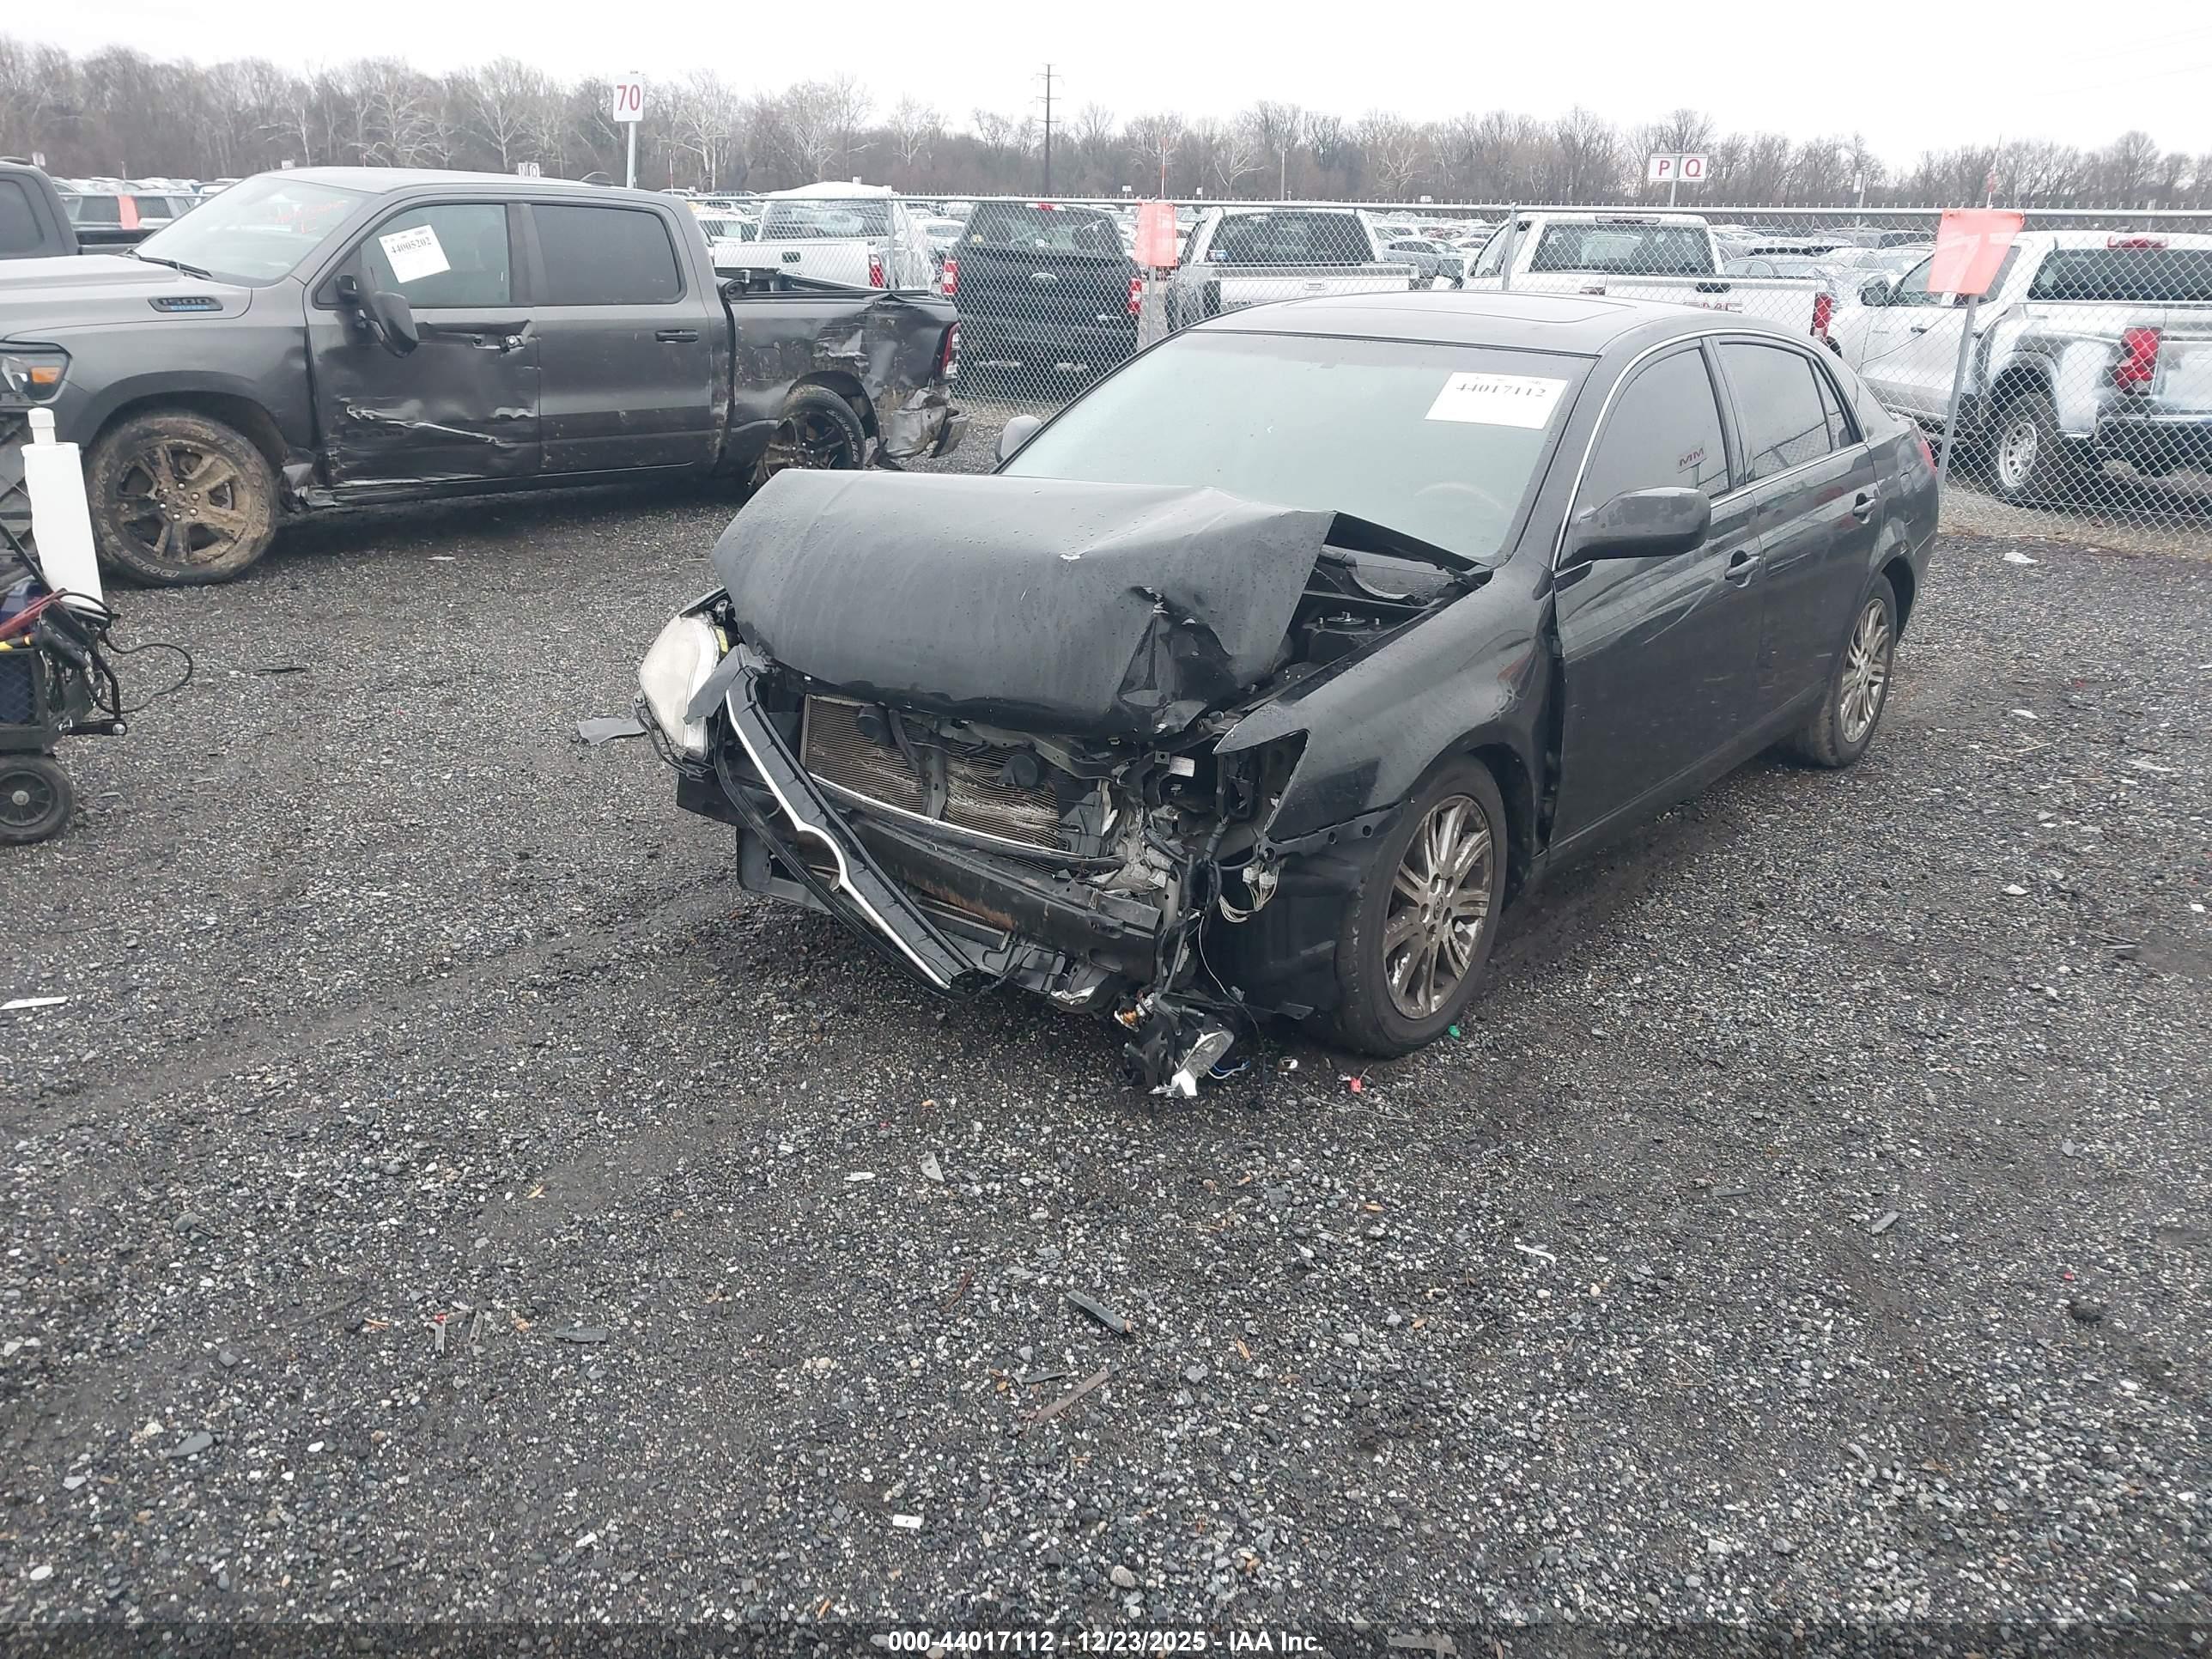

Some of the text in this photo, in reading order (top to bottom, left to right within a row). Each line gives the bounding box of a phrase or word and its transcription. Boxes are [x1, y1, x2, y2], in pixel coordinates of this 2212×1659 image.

[617, 84, 641, 111] 70
[1658, 159, 1702, 177] P Q
[1455, 383, 1547, 398] 44017112
